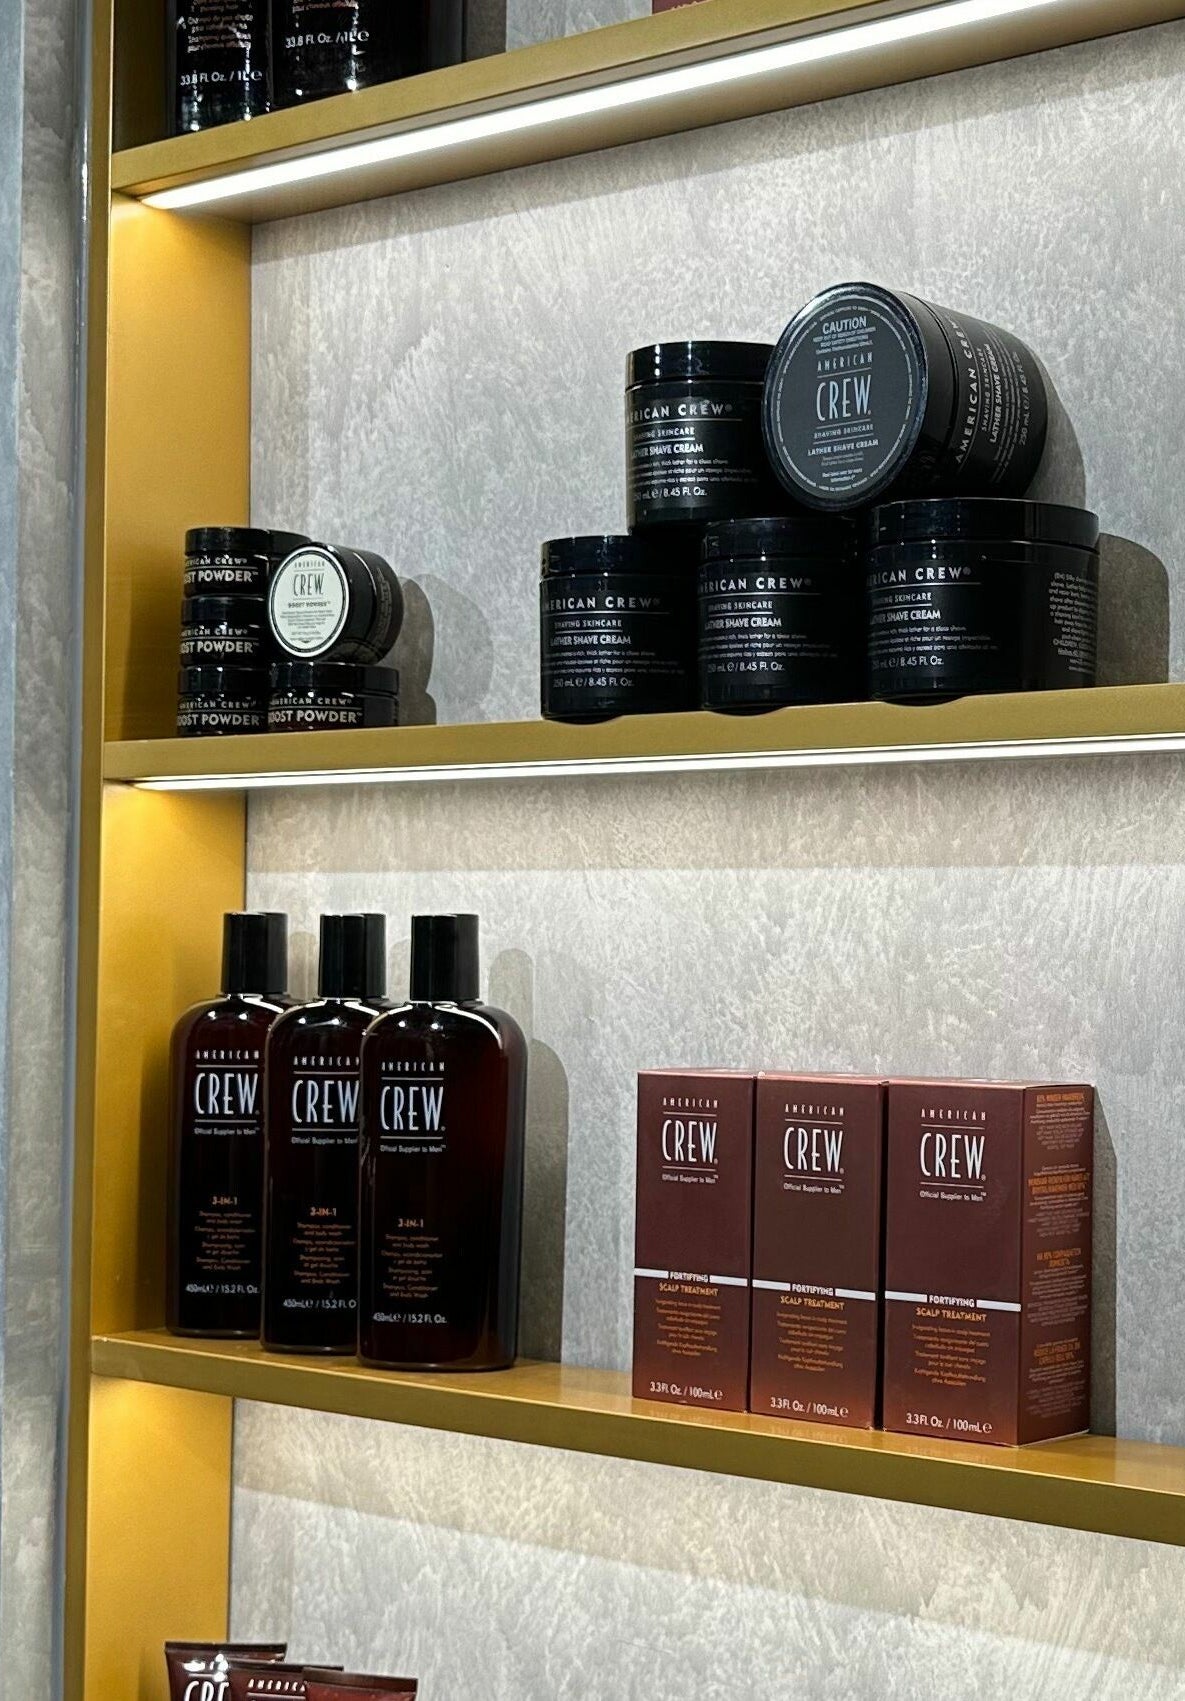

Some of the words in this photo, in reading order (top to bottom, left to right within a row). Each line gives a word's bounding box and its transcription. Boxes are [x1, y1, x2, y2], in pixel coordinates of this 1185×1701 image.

[822, 316, 867, 334] CAUTION
[817, 352, 873, 372] AMERICAN
[955, 367, 978, 464] AMERICAN
[673, 443, 704, 453] CREAM
[293, 572, 325, 596] CREW
[750, 616, 782, 627] CREAM
[910, 609, 941, 621] CREAM
[600, 634, 631, 645] CREAM
[196, 1050, 259, 1060] AMERICAN
[381, 1061, 445, 1071] AMERICAN
[663, 1097, 718, 1108] AMERICAN
[785, 1103, 844, 1116] AMERICAN
[921, 1108, 985, 1120] AMERICAN
[670, 1271, 709, 1283] FORTIFYING
[659, 1282, 679, 1293] SCALP
[680, 1285, 718, 1296] TREATMENT
[792, 1283, 833, 1296] FORTIFYING
[780, 1295, 802, 1306] SCALP
[803, 1298, 845, 1310] TREATMENT
[929, 1295, 975, 1308] FORTIFYING
[916, 1307, 940, 1317] SCALP
[941, 1309, 987, 1322] TREATMENT
